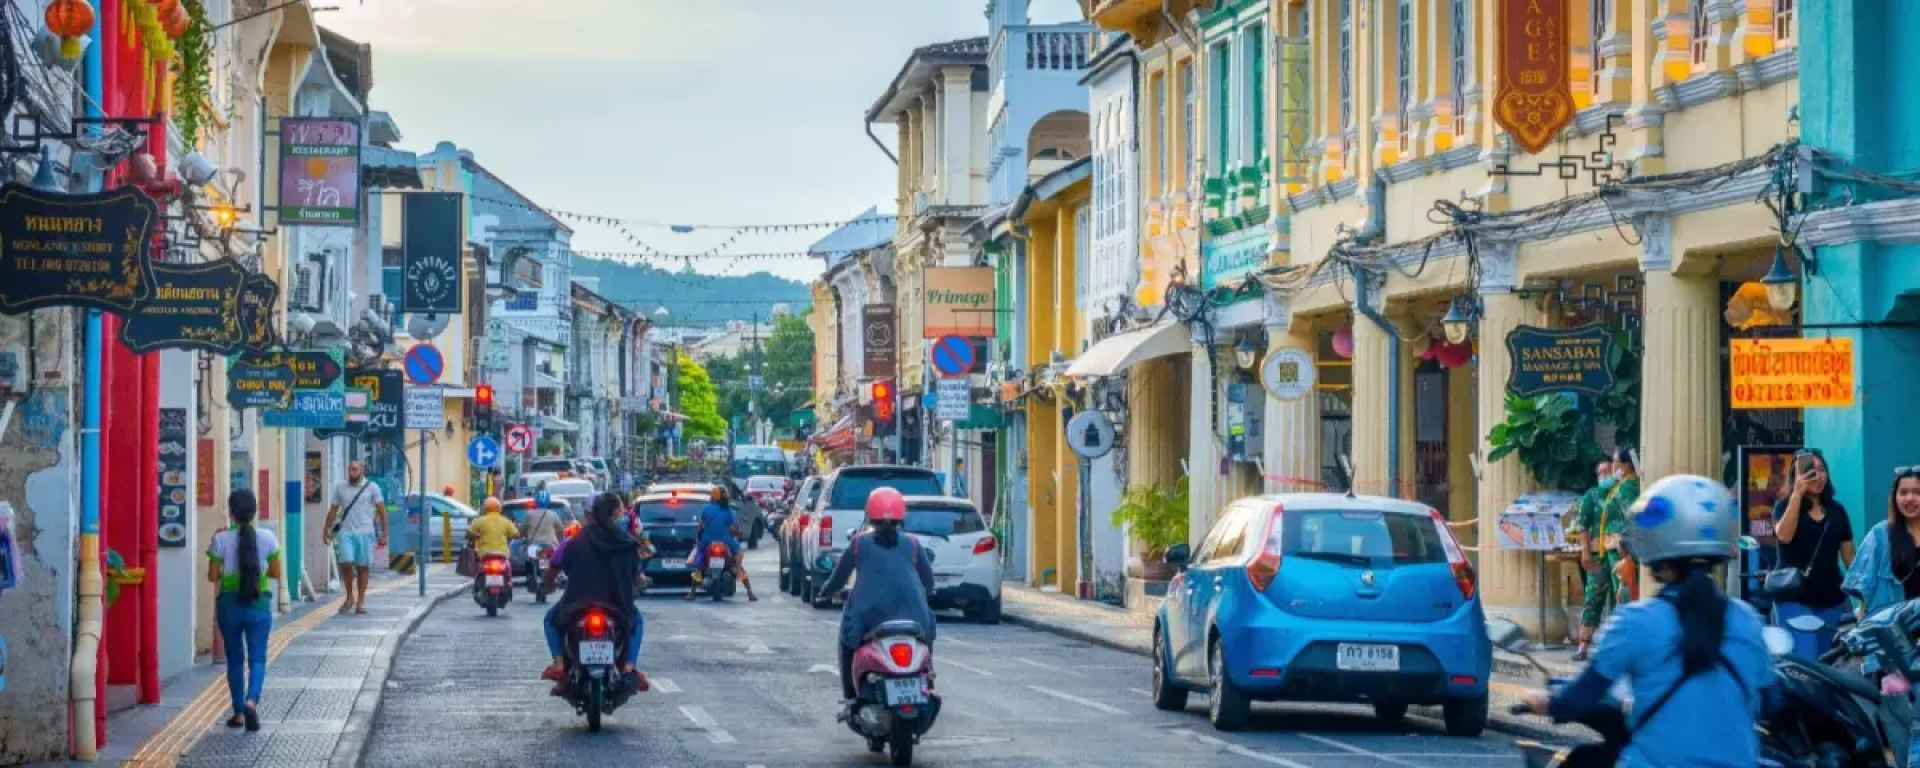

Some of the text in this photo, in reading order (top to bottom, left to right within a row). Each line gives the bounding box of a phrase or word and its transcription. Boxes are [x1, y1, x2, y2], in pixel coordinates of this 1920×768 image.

[407, 255, 456, 280] CHINO
[1522, 345, 1601, 360] SANSABAI
[1522, 361, 1571, 372] MASSAGE
[1573, 361, 1582, 371] &
[236, 379, 286, 391] CHINA INN
